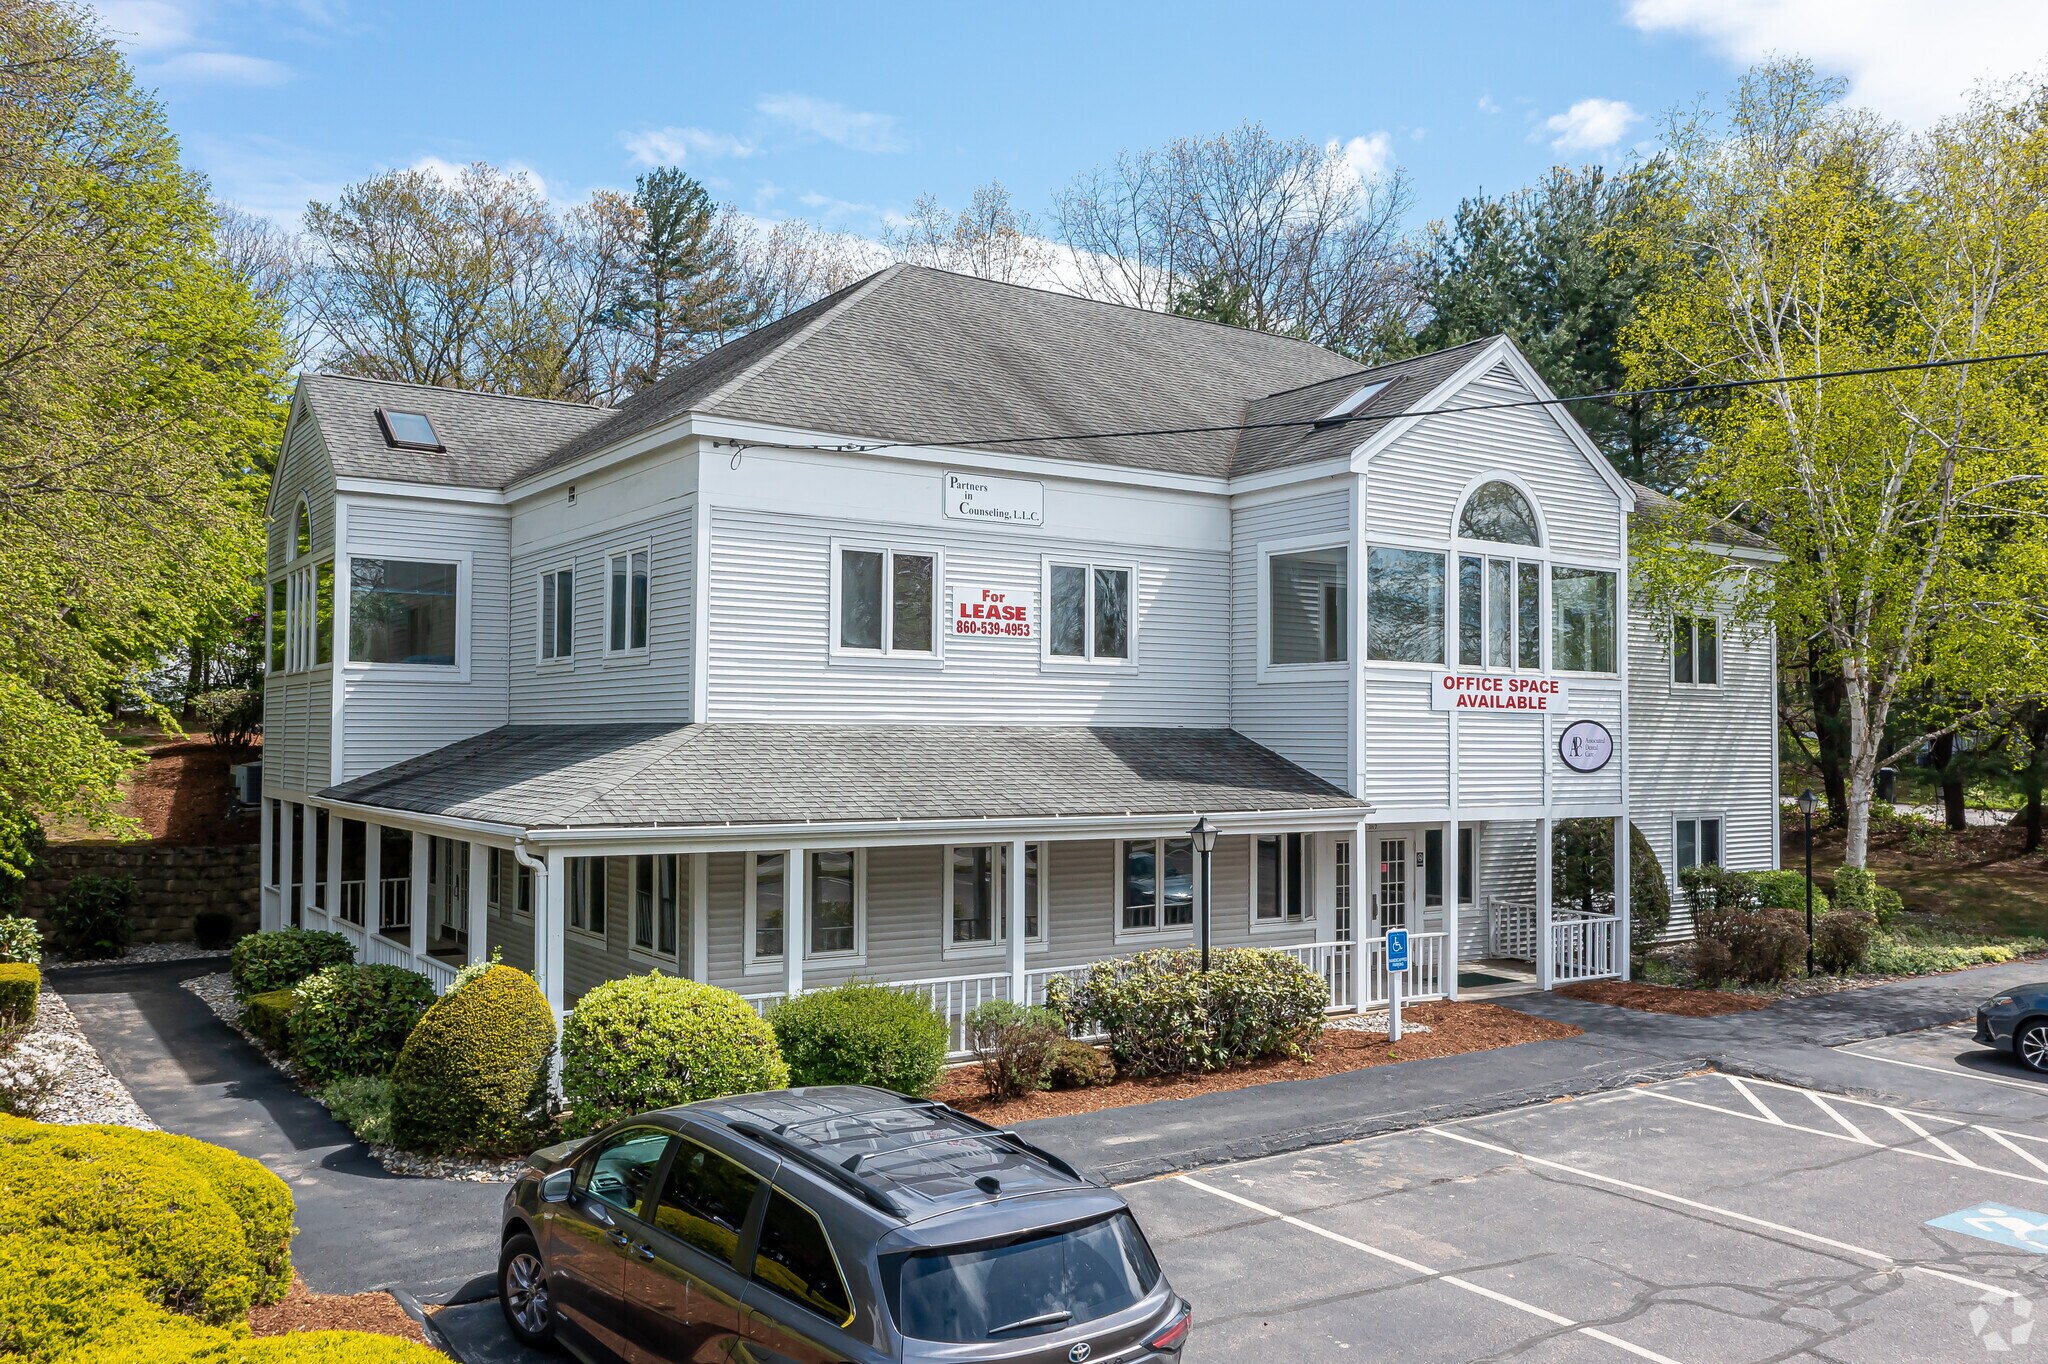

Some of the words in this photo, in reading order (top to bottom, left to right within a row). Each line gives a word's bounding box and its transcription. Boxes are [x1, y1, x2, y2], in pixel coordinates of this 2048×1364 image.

[950, 476, 988, 492] Partners
[964, 490, 973, 500] in
[959, 501, 1012, 520] Counseling,
[1013, 510, 1040, 521] L.L.C.
[982, 589, 1006, 603] For
[960, 603, 1027, 621] LEASE
[956, 620, 1030, 637] 860-539-4953
[1443, 676, 1503, 692] OFFICE
[1508, 679, 1559, 694] SPACE
[1456, 694, 1547, 710] AVAILABLE
